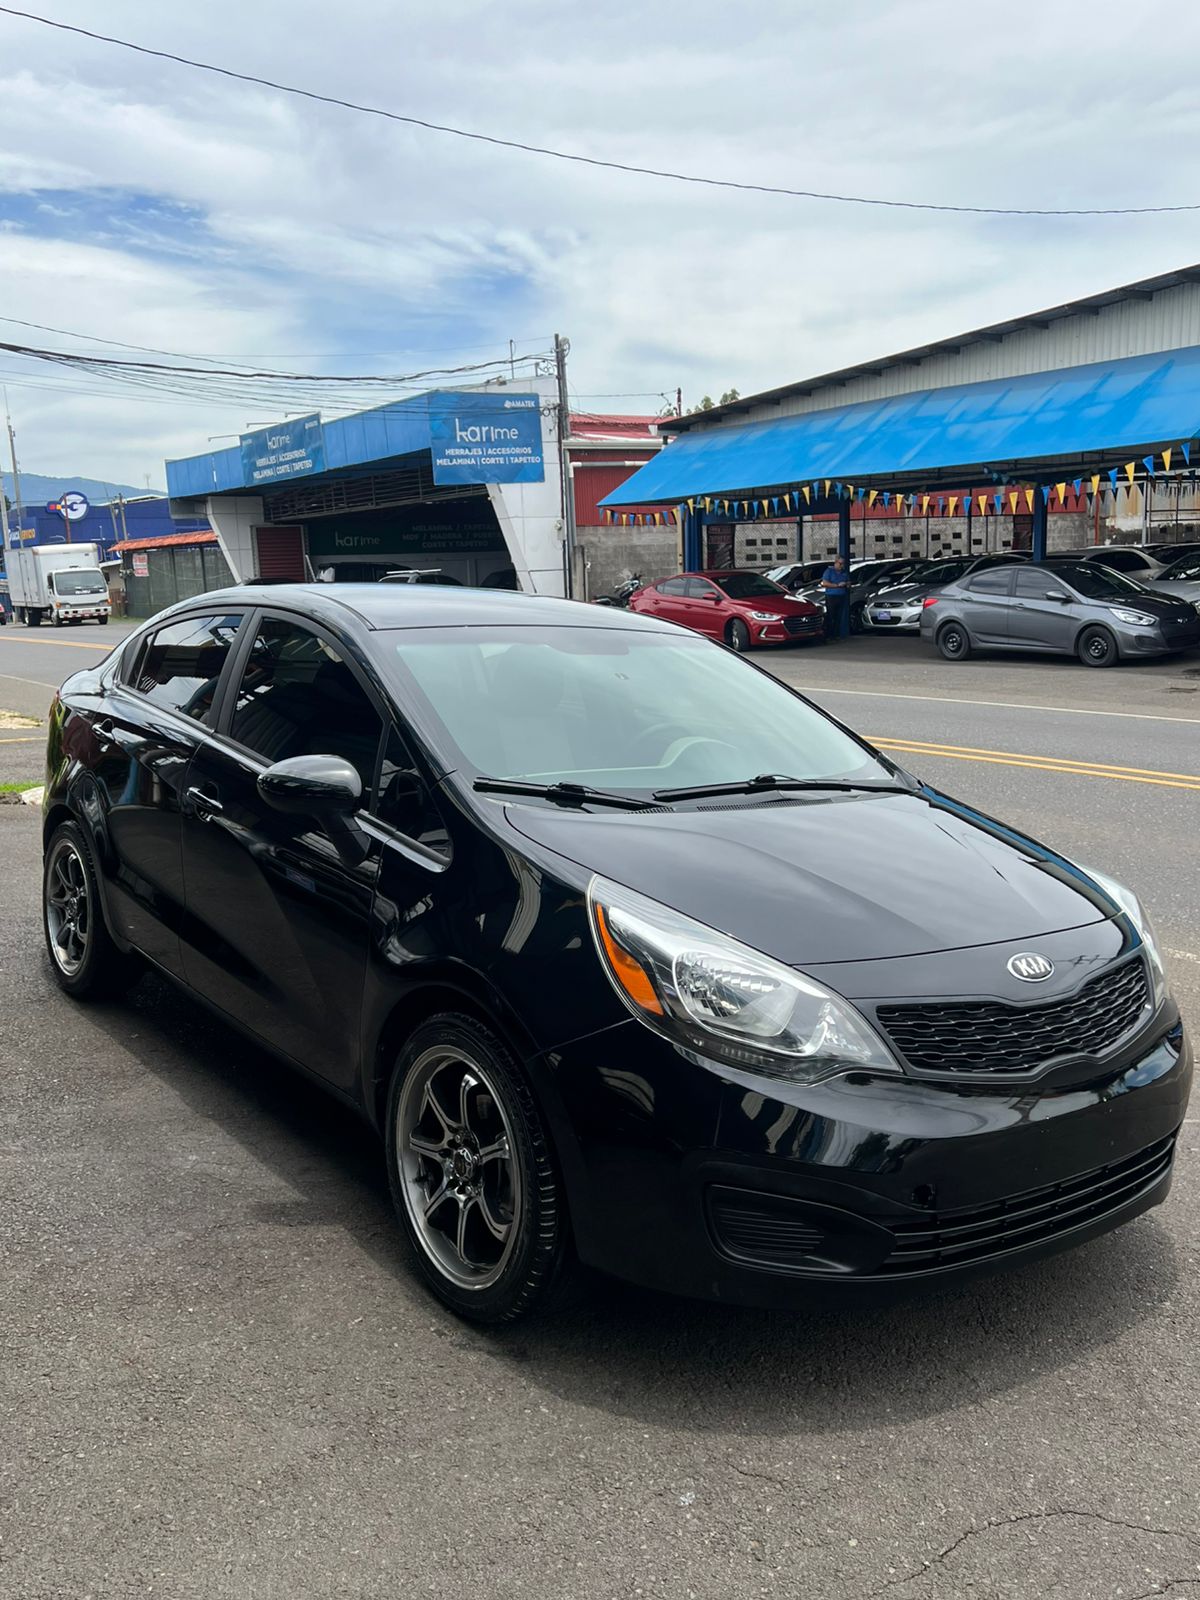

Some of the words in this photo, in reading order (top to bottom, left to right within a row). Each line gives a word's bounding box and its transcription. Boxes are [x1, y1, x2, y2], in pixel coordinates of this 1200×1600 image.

[455, 418, 519, 443] karime
[445, 447, 482, 456] HERRAJES
[487, 447, 532, 455] ACCESORIOS
[436, 458, 476, 466] MELAMINA
[481, 457, 505, 465] CORTE
[510, 456, 541, 464] TAPETEO
[1014, 956, 1051, 976] KIA
